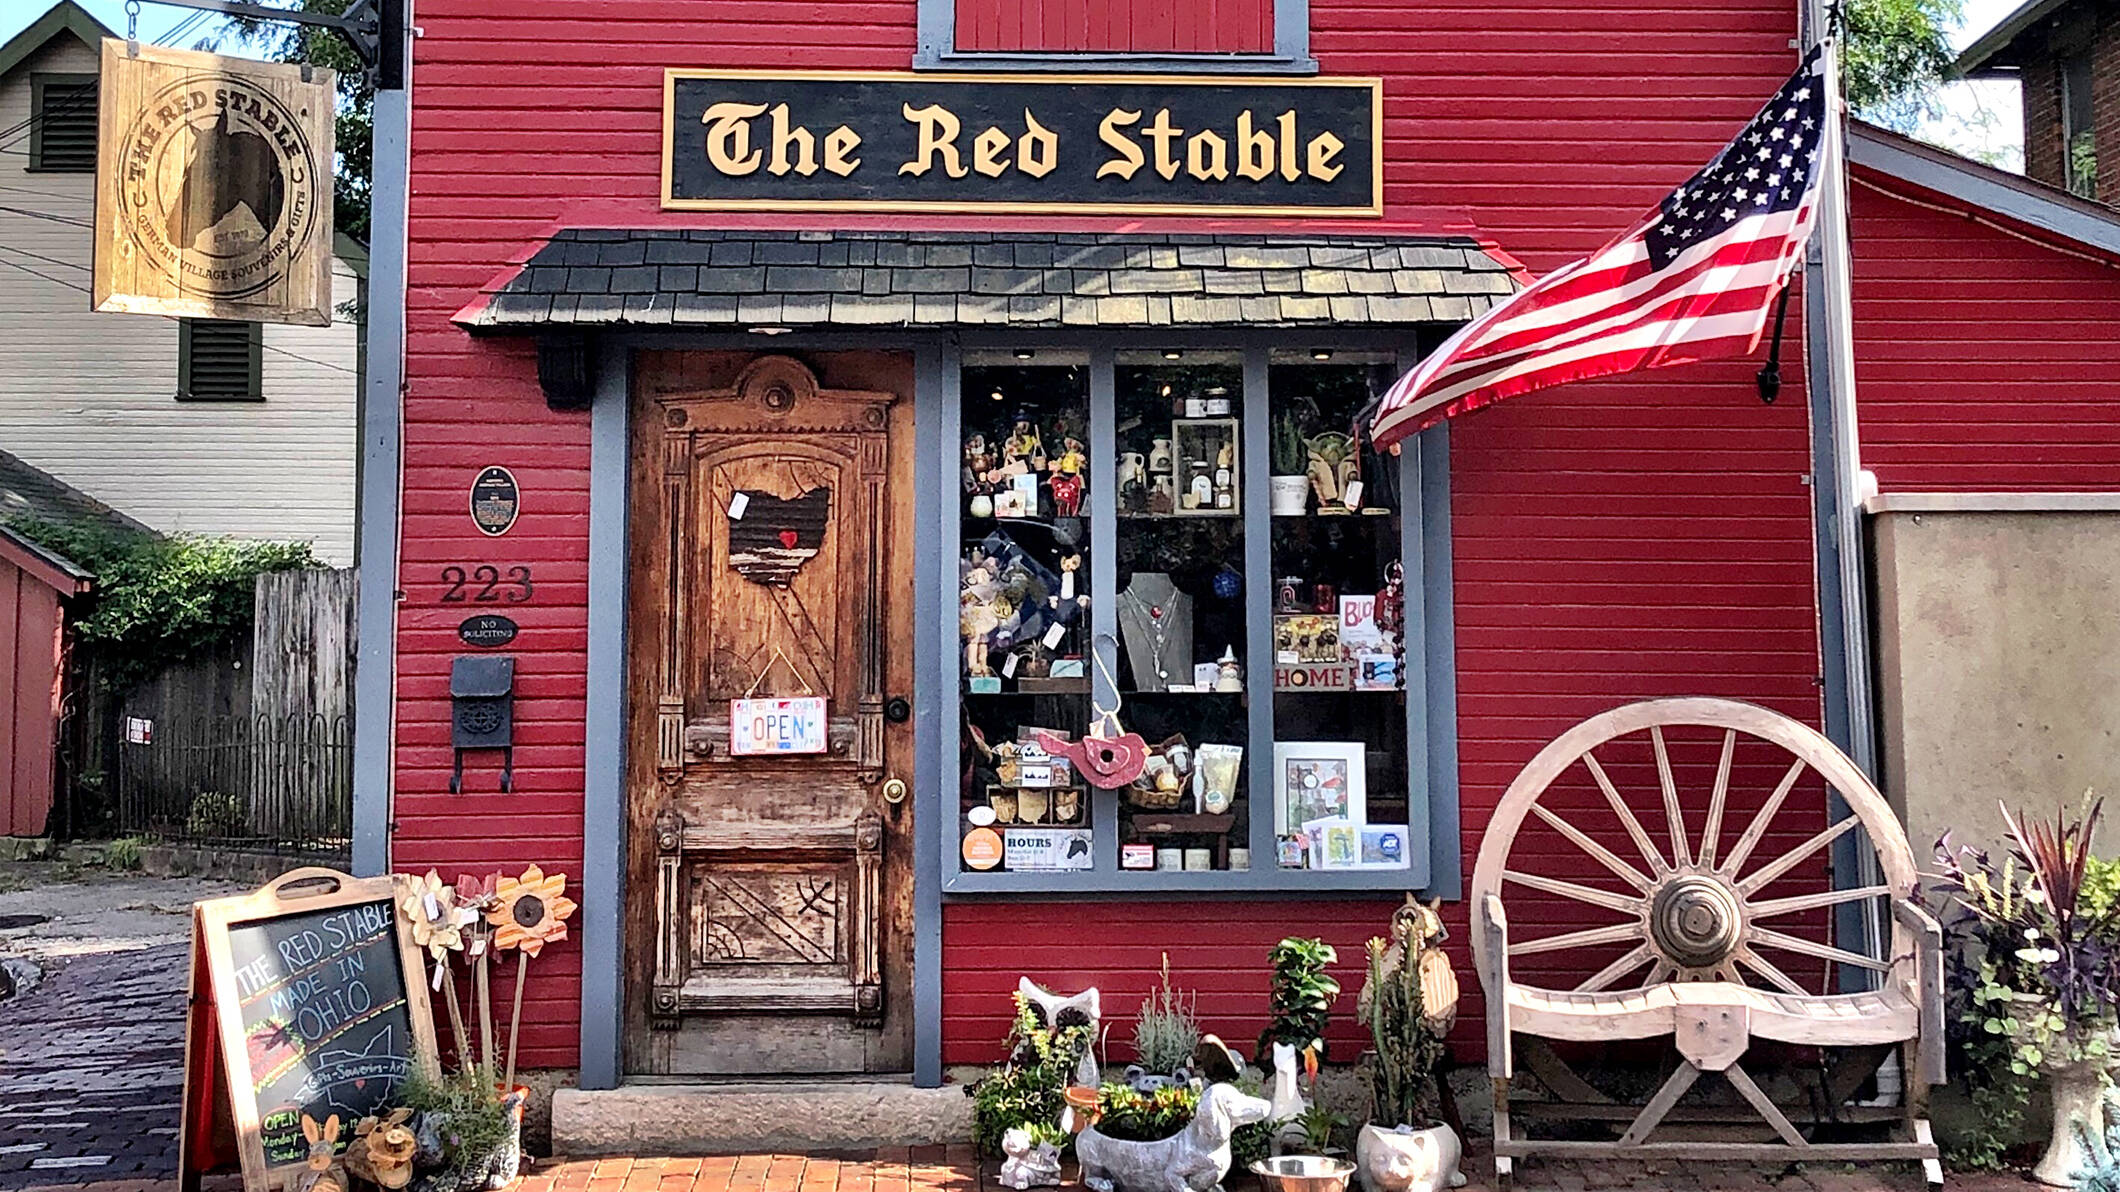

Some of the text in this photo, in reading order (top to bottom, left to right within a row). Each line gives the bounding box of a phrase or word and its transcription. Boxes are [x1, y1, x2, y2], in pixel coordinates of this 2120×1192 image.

[128, 89, 303, 181] THE RED STABLE
[701, 102, 1345, 182] The Red Stable
[137, 214, 179, 264] GERMAN
[180, 260, 229, 281] VILLAGE
[231, 238, 288, 280] SOUVENIRS
[292, 190, 306, 227] GIFTS
[440, 565, 534, 602] 223
[481, 620, 497, 629] NO
[1275, 667, 1344, 687] HOME
[753, 714, 805, 741] OPEN
[1007, 838, 1052, 848] HOURS
[234, 904, 393, 995] THE RED STABLE
[269, 951, 364, 1017] MADE IN
[298, 980, 370, 1040] OHIO
[264, 1109, 299, 1131] OPEN
[270, 1148, 305, 1162] Sunday
